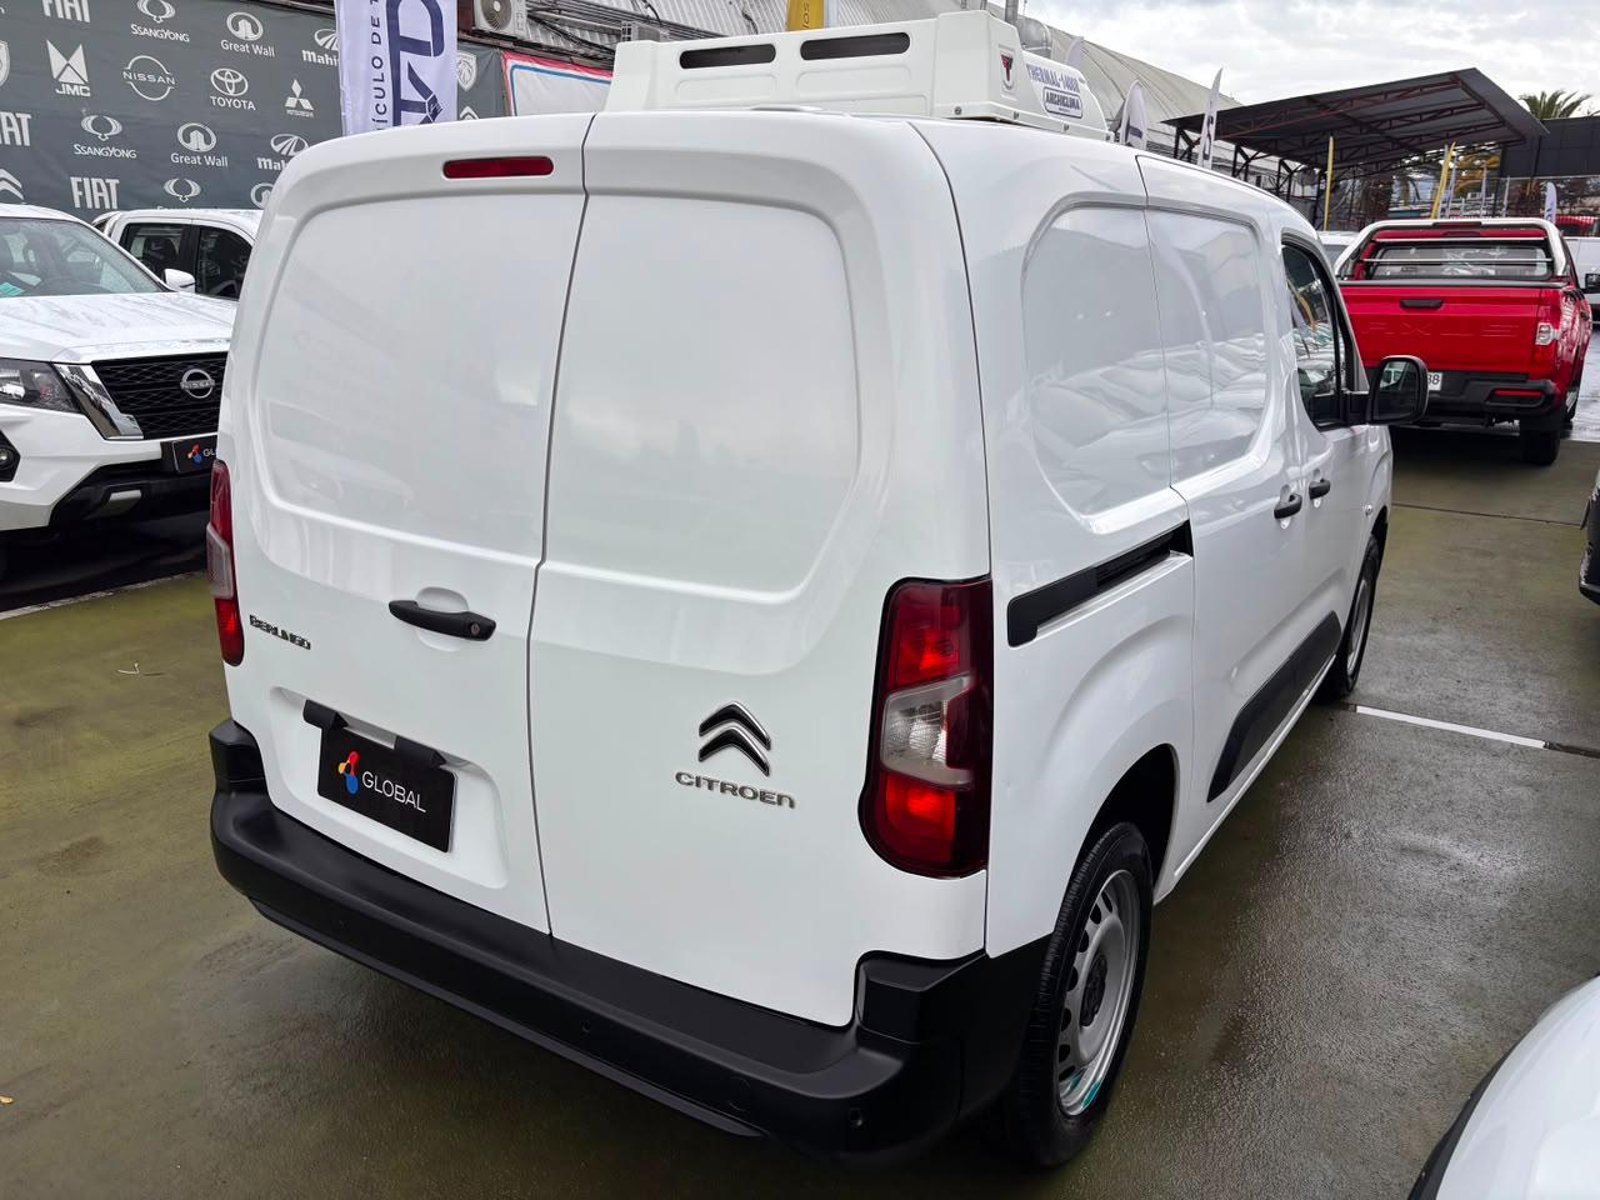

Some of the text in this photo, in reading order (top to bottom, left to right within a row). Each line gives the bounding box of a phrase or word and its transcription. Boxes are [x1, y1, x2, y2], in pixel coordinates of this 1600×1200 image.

[371, 16, 382, 45] DE
[220, 39, 275, 58] Great Wall
[122, 71, 176, 85] NISSAN
[55, 83, 91, 97] JMC
[210, 95, 257, 111] TOYOTA
[0, 111, 32, 147] AT
[170, 152, 229, 168] Great Wall
[70, 176, 120, 209] FIAT
[361, 770, 427, 813] GLOBAL
